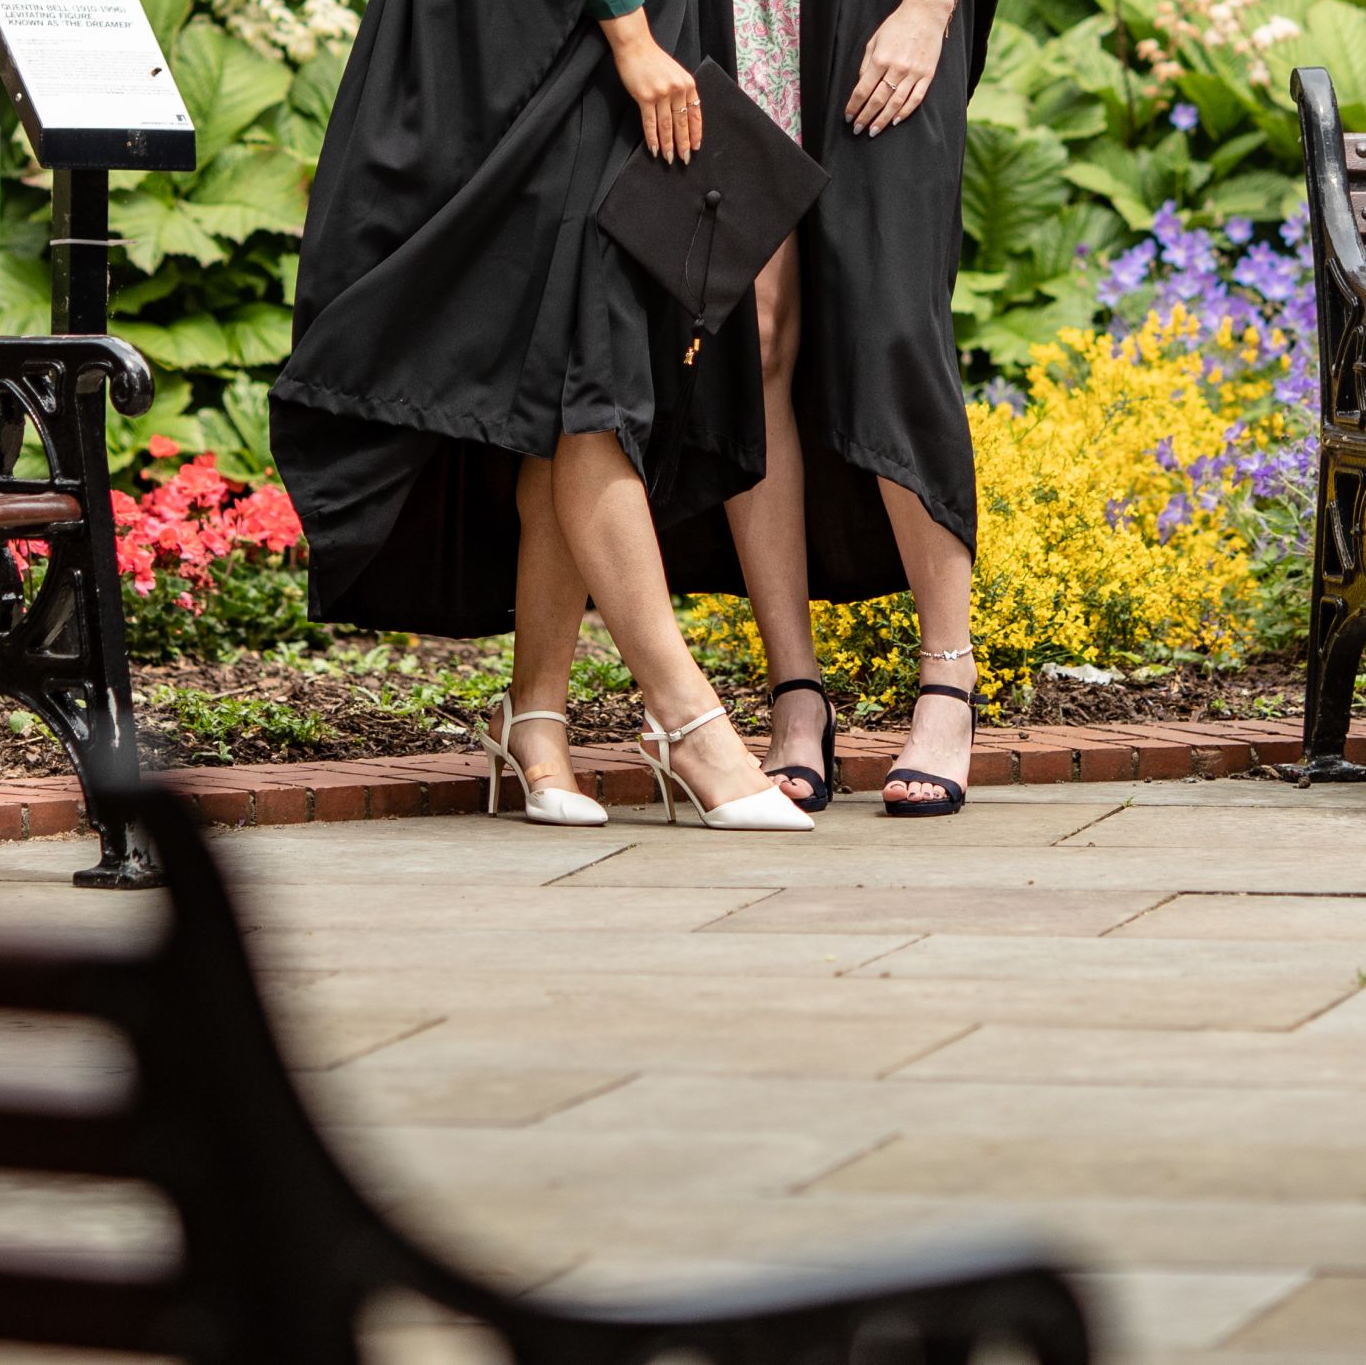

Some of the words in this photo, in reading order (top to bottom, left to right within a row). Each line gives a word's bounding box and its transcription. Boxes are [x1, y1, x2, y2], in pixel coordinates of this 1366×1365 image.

[1, 3, 44, 11] QUENTIN
[46, 4, 70, 12] BELL
[5, 11, 56, 19] LEVITATING
